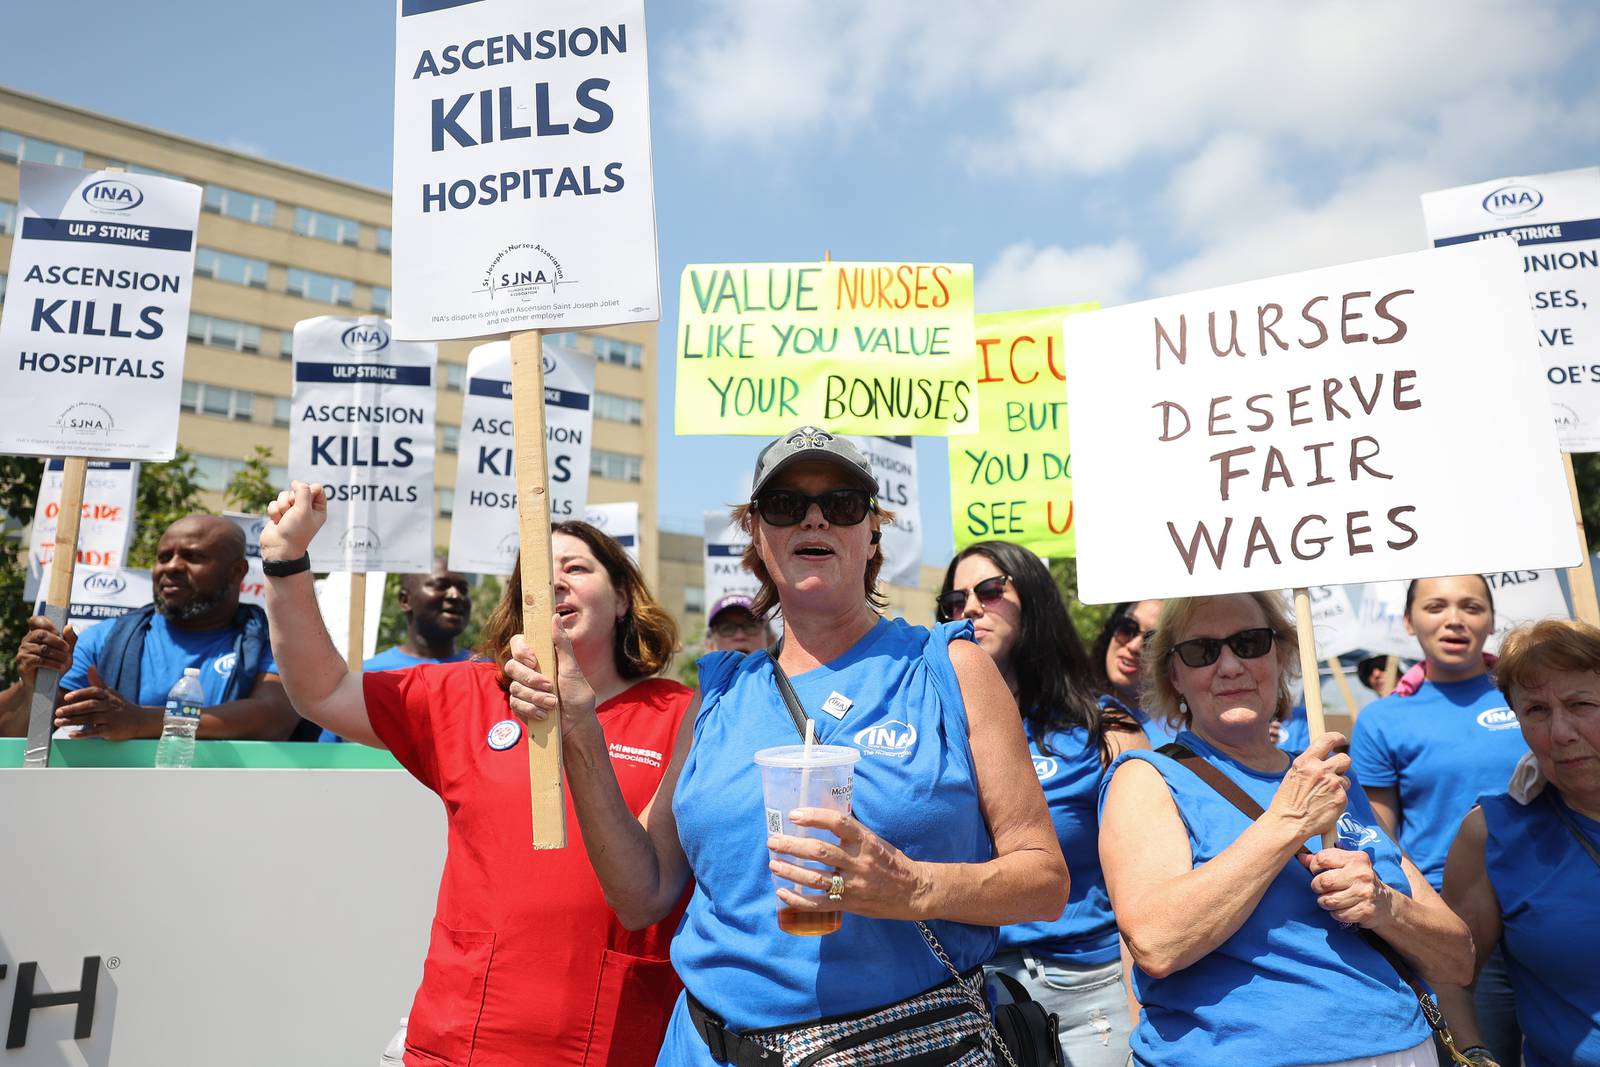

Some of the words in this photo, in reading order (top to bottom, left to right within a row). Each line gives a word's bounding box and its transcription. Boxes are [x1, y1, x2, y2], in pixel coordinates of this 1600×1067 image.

[412, 23, 627, 80] ASCENSION
[431, 77, 614, 152] KILLS
[94, 186, 133, 202] INA
[422, 162, 625, 213] HOSPITALS
[1494, 192, 1533, 207] INA
[68, 223, 96, 237] ULP
[99, 225, 150, 242] STRIKE
[1510, 224, 1562, 240] STRIKE
[534, 244, 564, 279] Association
[24, 264, 180, 294] ASCENSION
[501, 270, 546, 287] SJNA
[691, 268, 822, 314] VALUE
[836, 265, 952, 311] NURSES
[431, 315, 450, 323] INA's
[450, 313, 477, 323] dispute
[484, 310, 498, 318] only
[500, 306, 515, 315] with
[516, 303, 552, 313] Ascension
[553, 302, 571, 311] Saint
[572, 300, 599, 310] Joseph
[600, 299, 620, 308] Joliet
[1531, 289, 1587, 309] SES,
[30, 298, 164, 340] KILLS
[486, 318, 500, 326] and
[510, 314, 529, 322] other
[530, 311, 565, 321] employer
[1154, 289, 1415, 370] NURSES
[351, 331, 382, 343] INA
[683, 323, 755, 359] LIKE
[771, 324, 838, 357] YOU
[854, 326, 951, 356] VALUE
[1538, 328, 1574, 347] VE
[19, 351, 165, 379] HOSPITALS
[333, 366, 356, 378] ULP
[357, 367, 397, 380] STRIKE
[1547, 365, 1600, 384] OE'S
[707, 376, 800, 418] YOUR
[823, 375, 970, 423] BONUSES
[1152, 369, 1422, 442] DESERVE
[70, 419, 103, 429] SJNA
[302, 405, 424, 424] ASCENSION
[1006, 401, 1068, 432] BUT
[311, 435, 414, 468] KILLS
[477, 446, 571, 483] KIS
[964, 449, 1029, 485] YOU
[1209, 435, 1394, 501] FAIR
[321, 484, 417, 502] OSPITALS
[967, 501, 1027, 537] SEE
[1166, 505, 1419, 575] WAGES
[92, 578, 119, 589] INA
[70, 604, 92, 616] ULP
[92, 606, 129, 617] STRIKE
[867, 728, 909, 747] INA
[609, 750, 660, 768] Association
